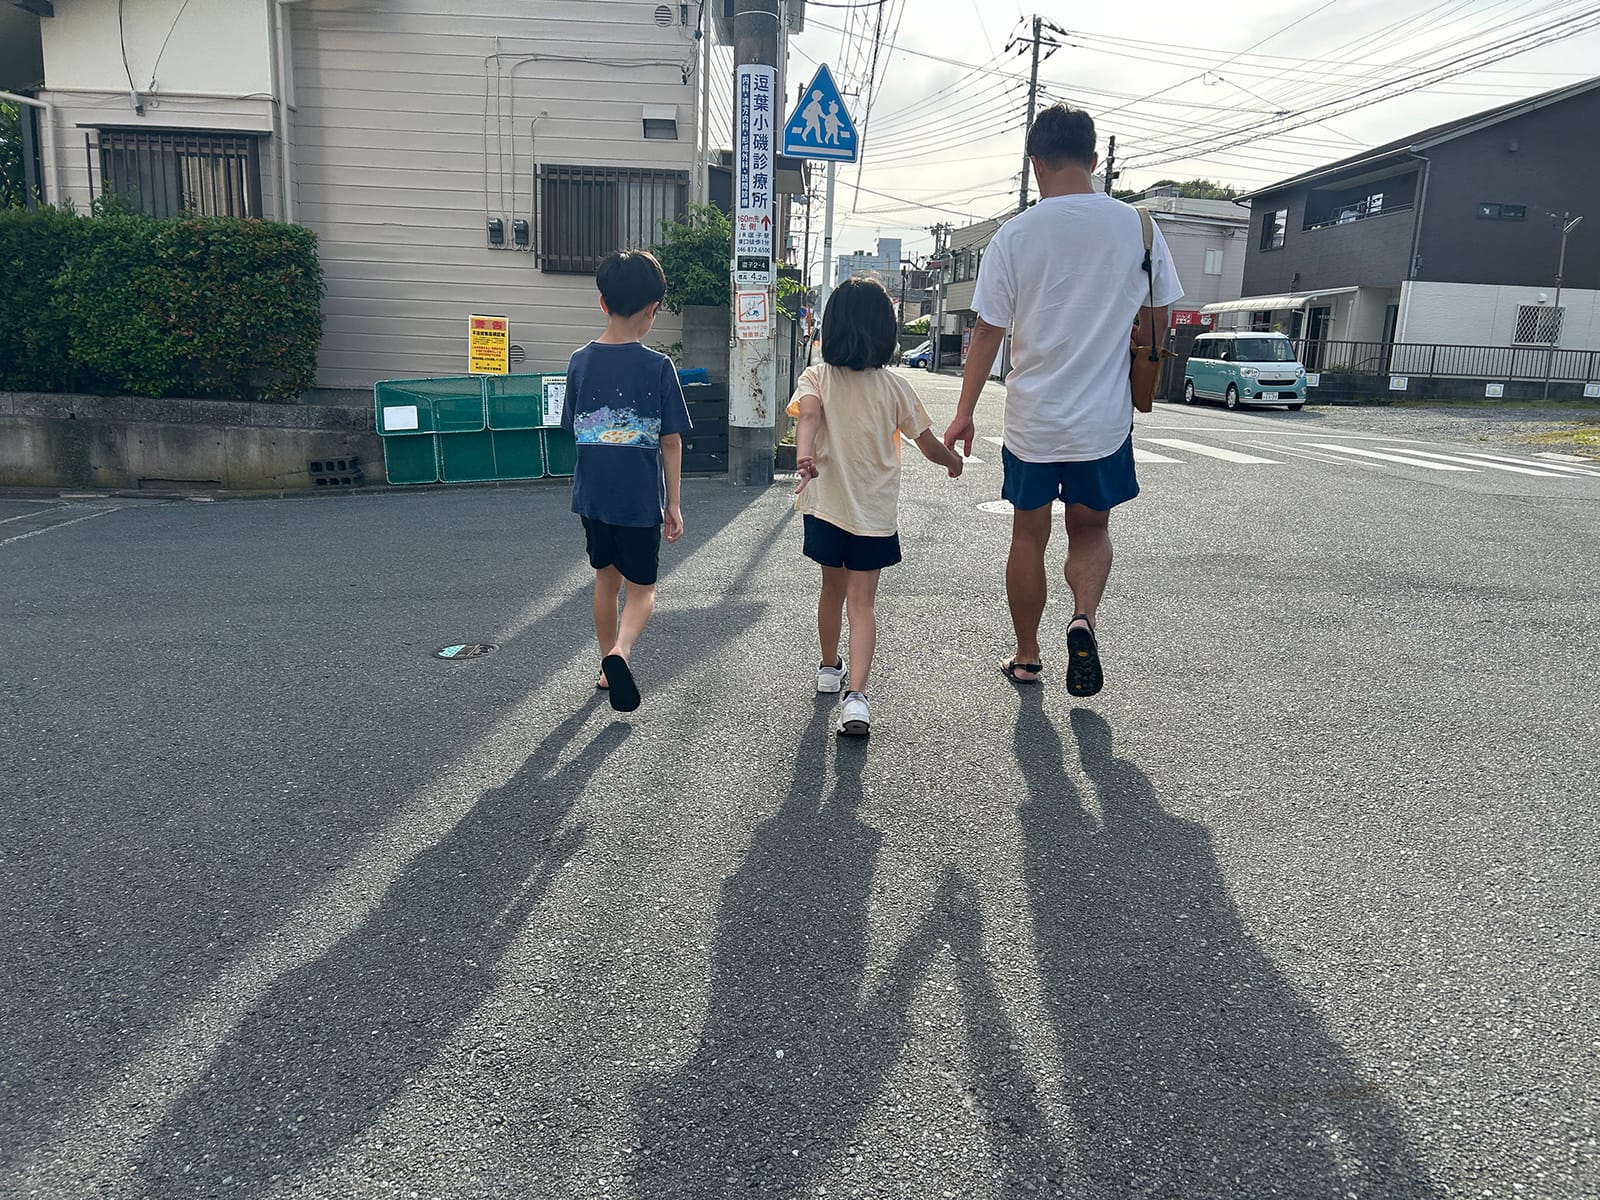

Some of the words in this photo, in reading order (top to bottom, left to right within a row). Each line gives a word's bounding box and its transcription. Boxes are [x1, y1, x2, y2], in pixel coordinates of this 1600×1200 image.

[752, 75, 769, 209] 逗葉小磯診療所
[740, 223, 757, 231] 左側
[750, 272, 768, 281] 4.2m
